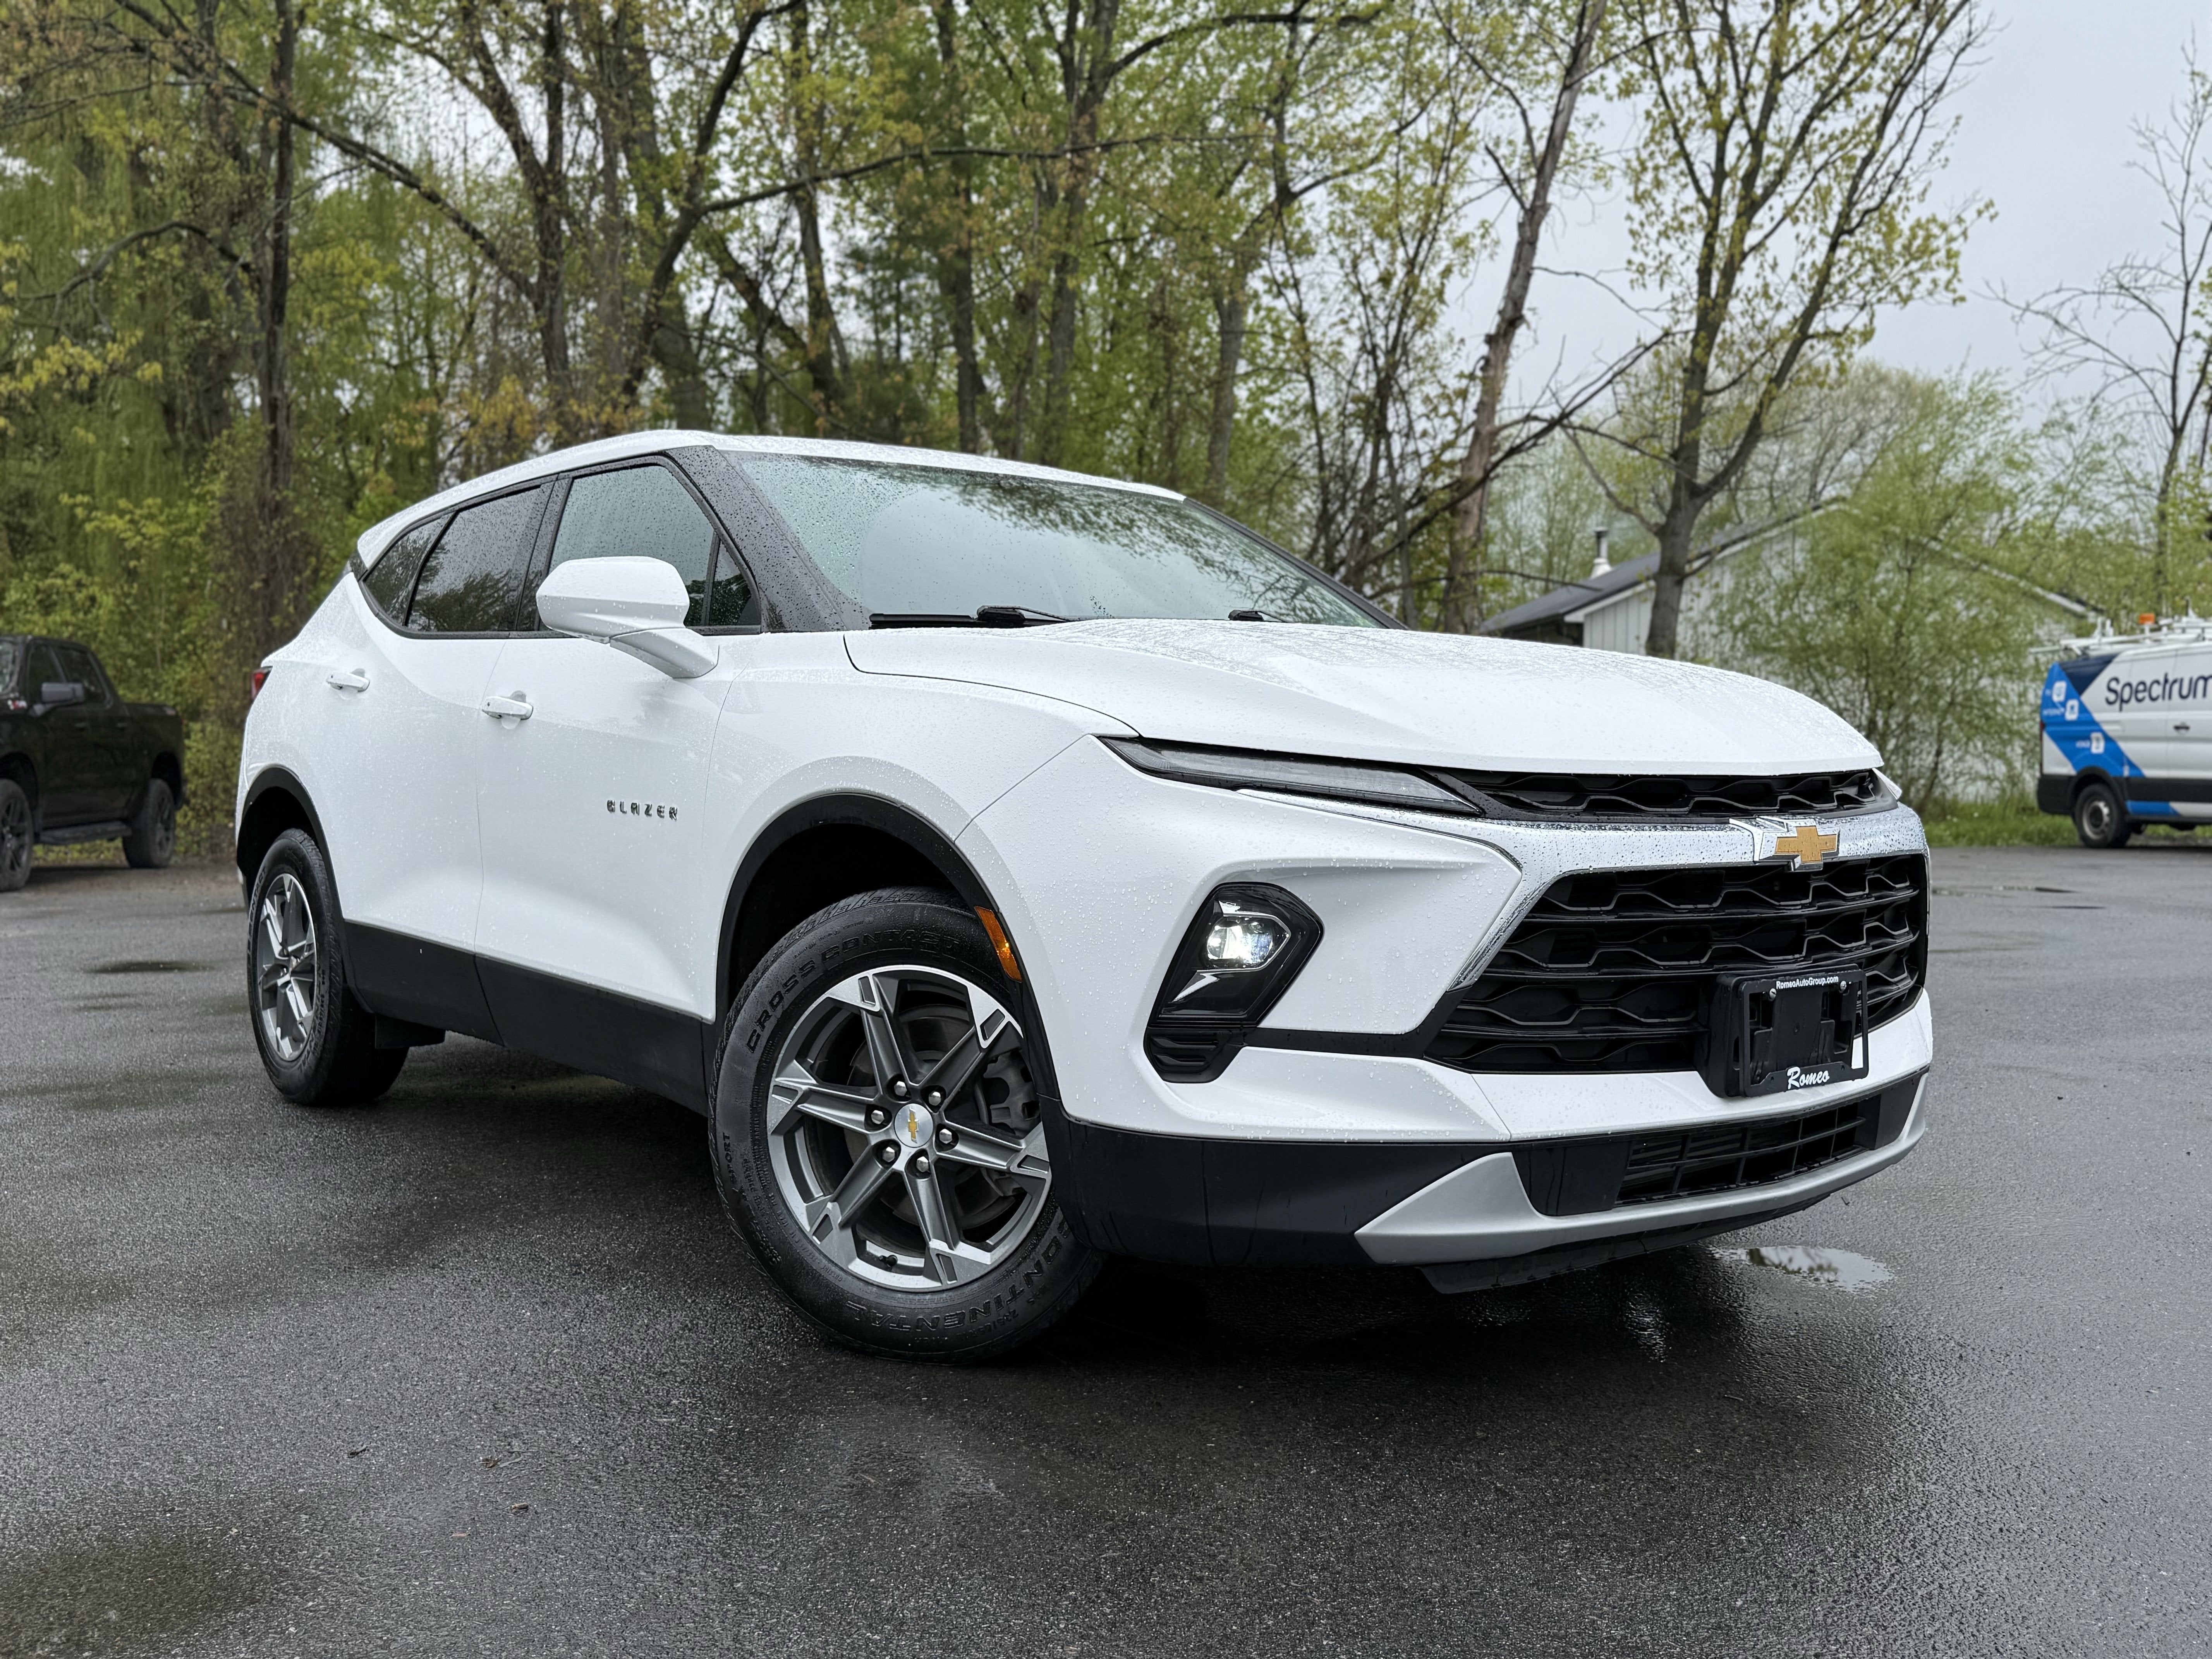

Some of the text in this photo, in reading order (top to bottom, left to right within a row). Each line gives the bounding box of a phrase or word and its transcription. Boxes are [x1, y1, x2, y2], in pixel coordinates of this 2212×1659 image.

[2106, 673, 2212, 712] Spectrum
[607, 800, 677, 821] BLAZER
[745, 960, 816, 1053] CROSS
[821, 929, 960, 962] CONTACT
[1776, 976, 1839, 989] RomeoAutoGroup.com
[1787, 1066, 1830, 1089] Romeo
